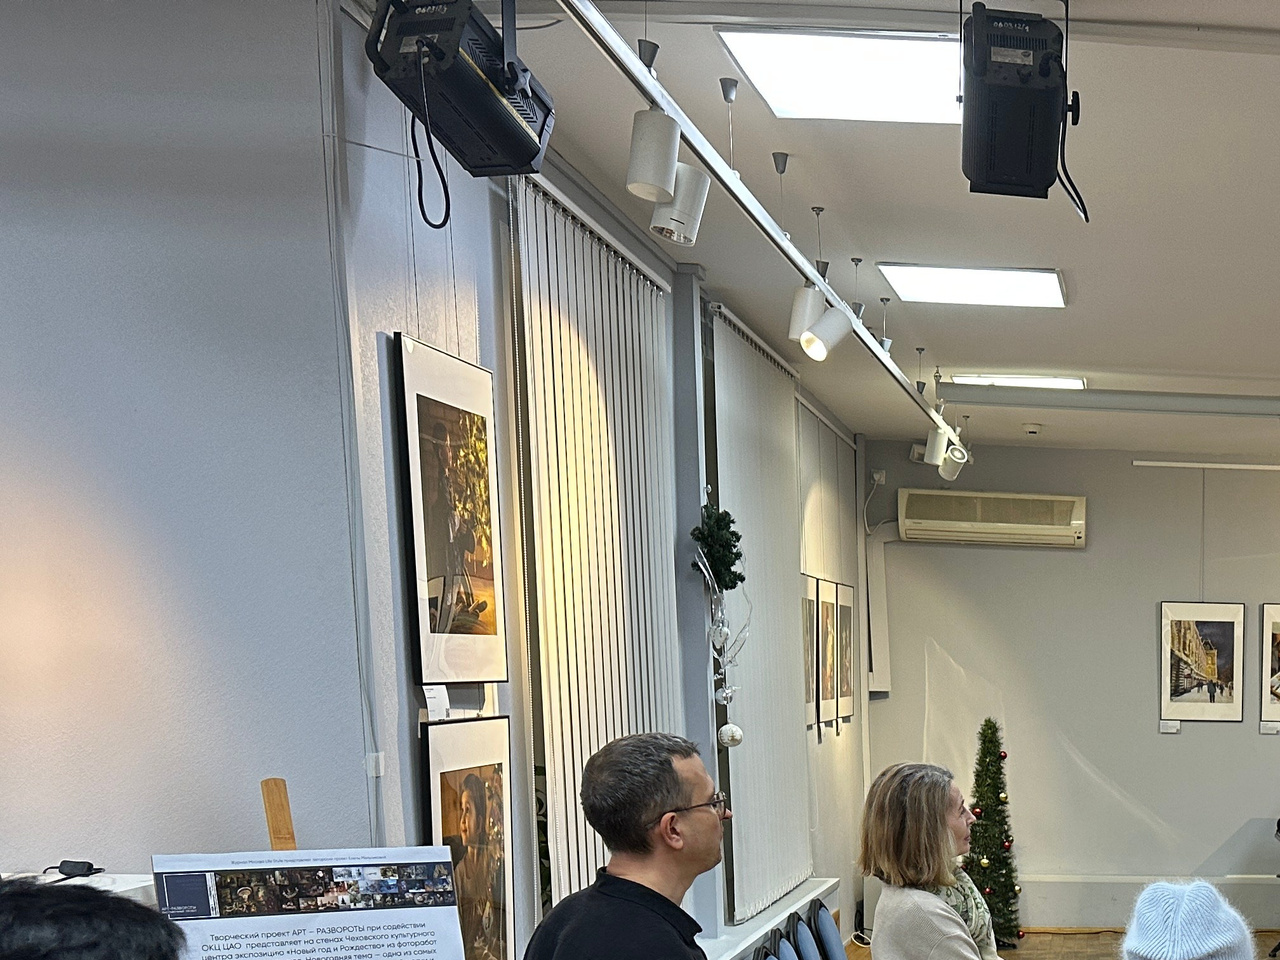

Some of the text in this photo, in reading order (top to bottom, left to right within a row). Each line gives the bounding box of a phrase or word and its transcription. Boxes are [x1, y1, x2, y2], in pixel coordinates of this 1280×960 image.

[201, 943, 221, 952] ОКЦ
[221, 942, 242, 951] ЦАО
[245, 939, 302, 950] представляет
[344, 933, 389, 941] Чеховского
[390, 930, 435, 940] культурного
[209, 931, 259, 942] Творческий
[260, 930, 290, 939] проект
[316, 925, 365, 934] РАЗВОРОТЫ
[382, 922, 425, 930] содействии
[234, 950, 284, 959] экспозицию
[396, 938, 436, 948] фоторабот
